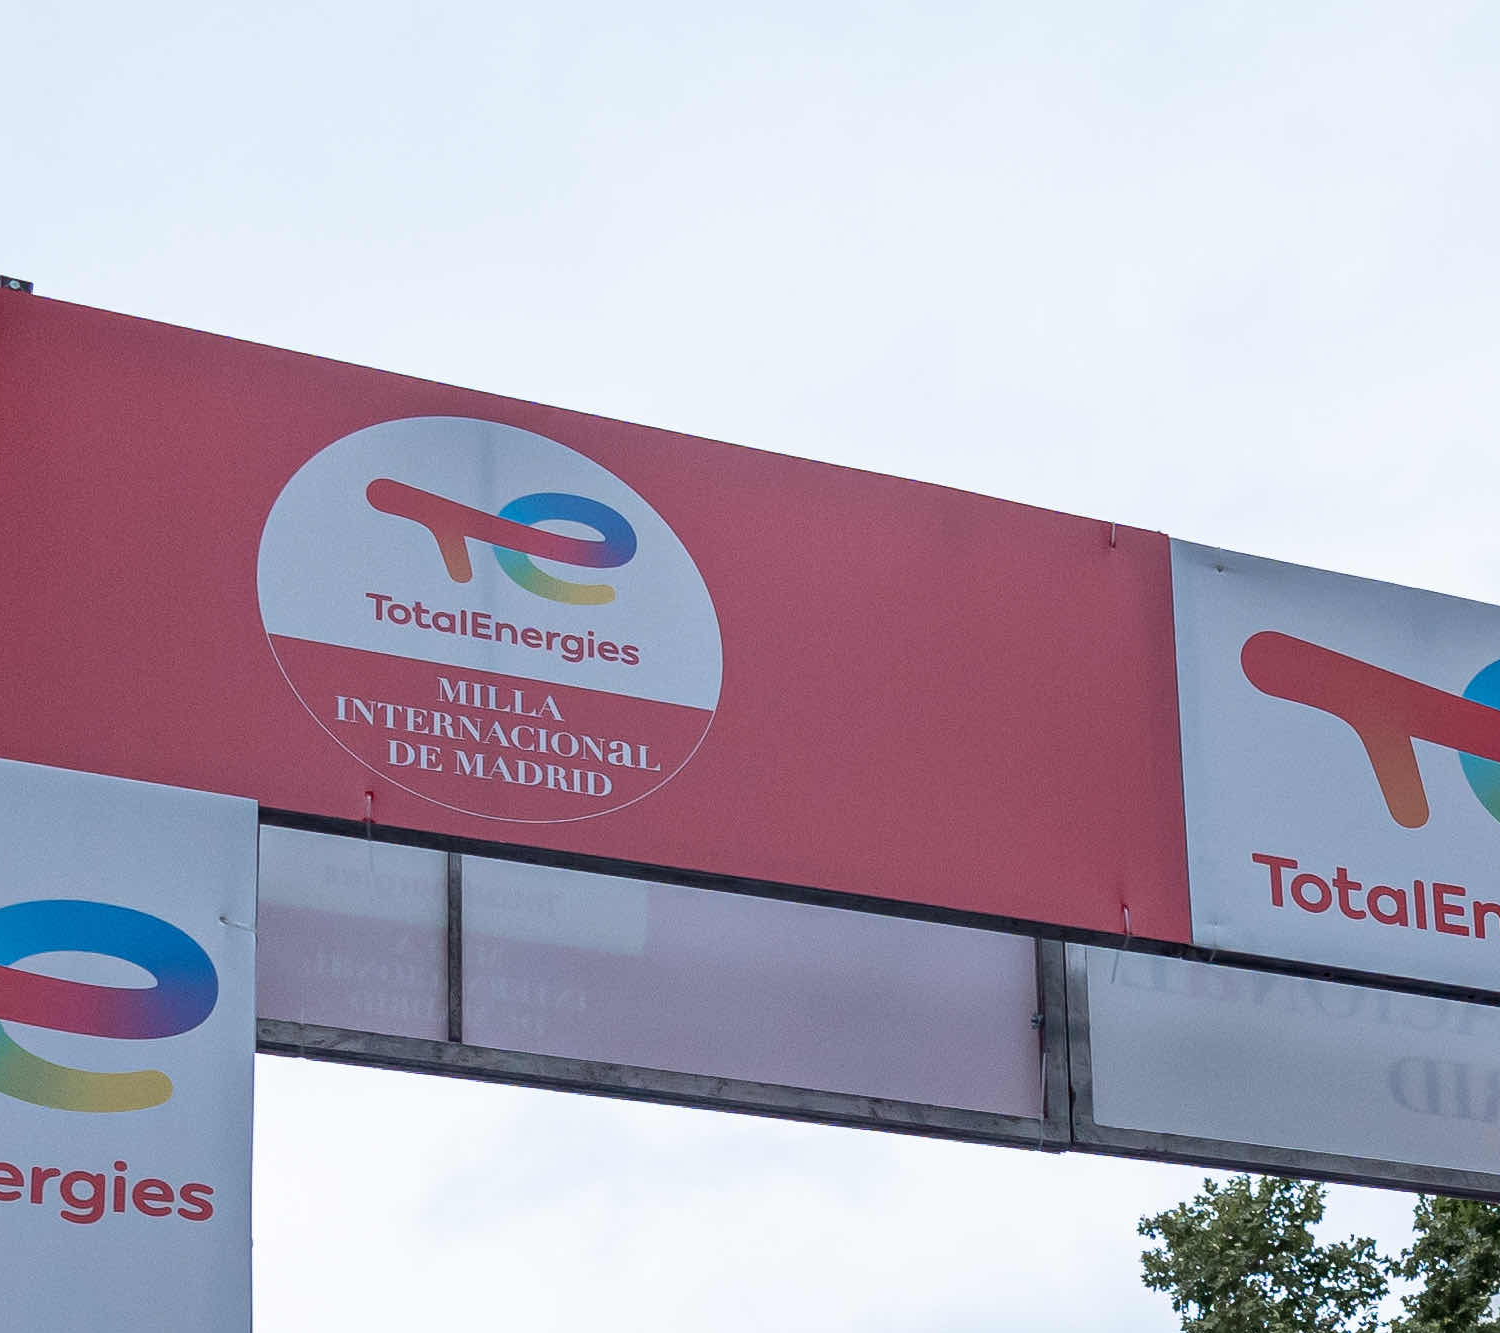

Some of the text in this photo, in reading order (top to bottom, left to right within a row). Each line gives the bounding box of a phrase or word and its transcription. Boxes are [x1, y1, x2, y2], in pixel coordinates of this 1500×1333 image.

[365, 589, 642, 667] TotalEnergies
[435, 675, 565, 722] MILLA
[385, 738, 614, 798] DE MADRID
